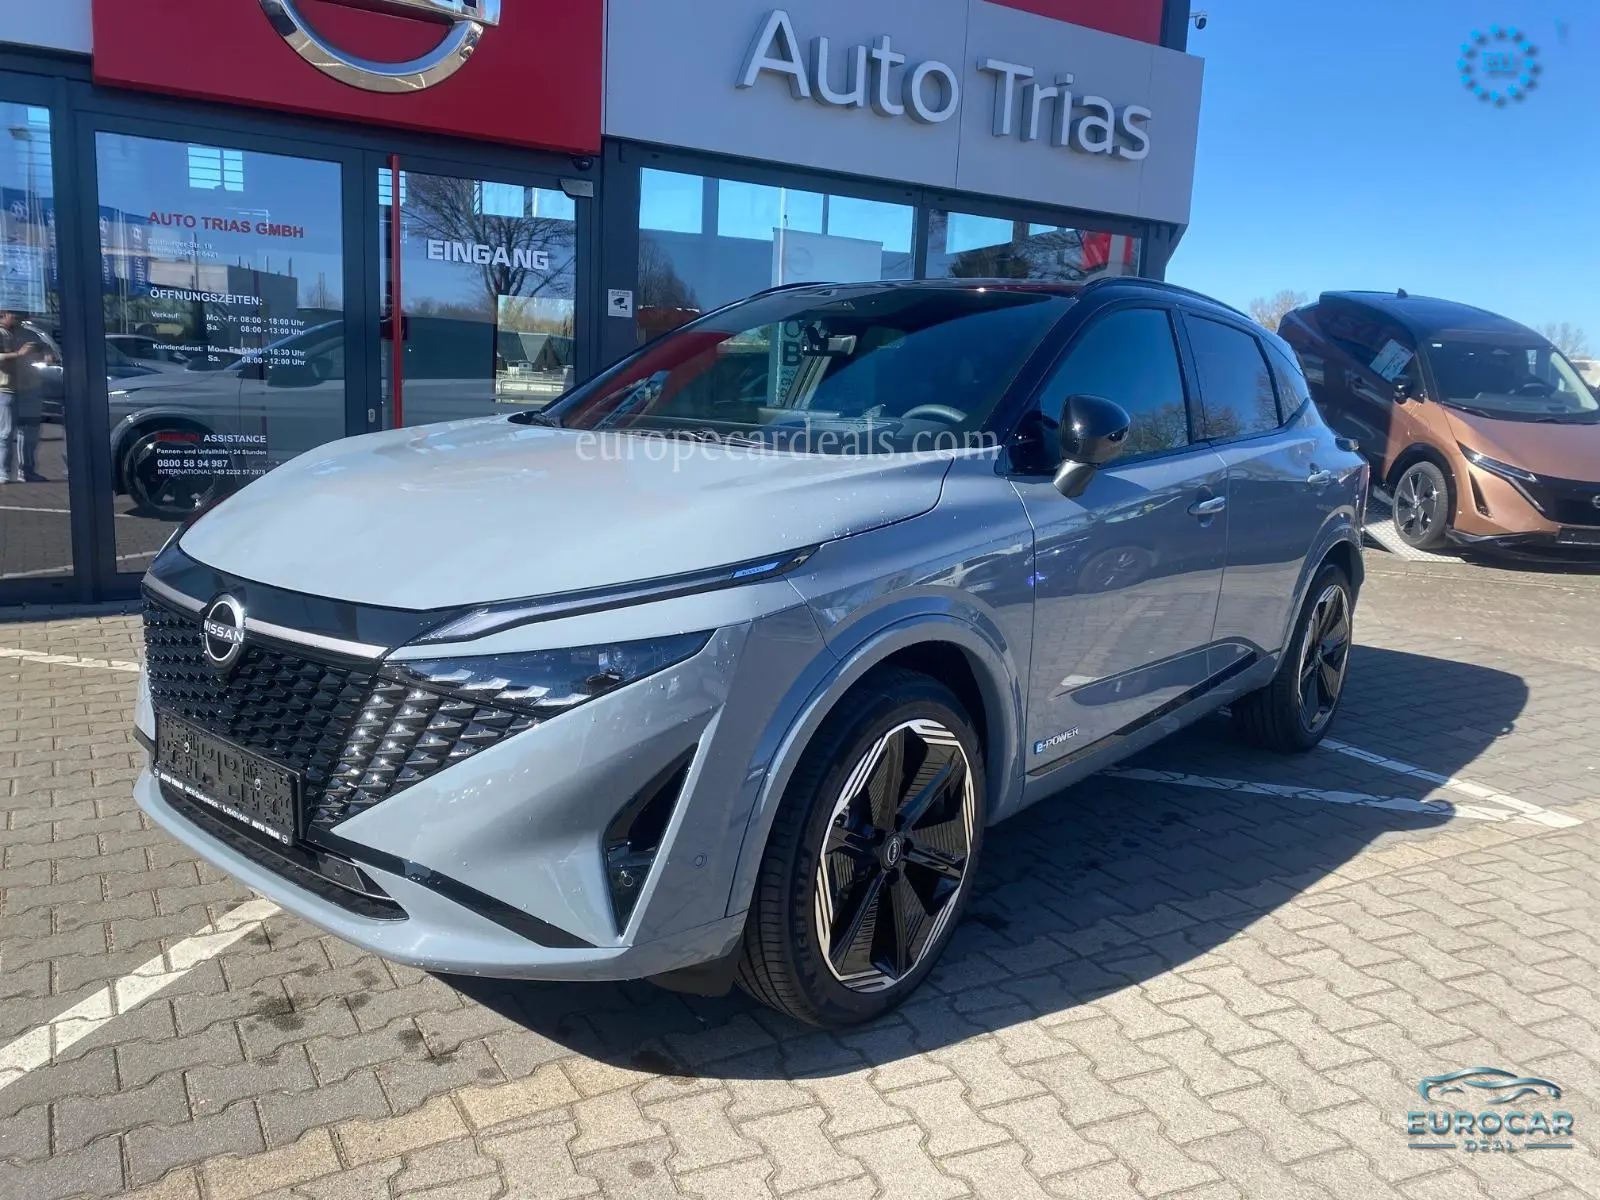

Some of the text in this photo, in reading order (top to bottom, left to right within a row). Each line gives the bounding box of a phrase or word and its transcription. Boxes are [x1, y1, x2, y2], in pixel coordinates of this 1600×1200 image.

[735, 9, 1152, 161] Auto Trias
[147, 211, 304, 238] AUTO TRIAS GMBH
[427, 239, 549, 270] EINGANG
[150, 286, 263, 306] ÖFFNUNGSZEITEN:
[206, 313, 221, 321] Mo.
[291, 319, 305, 327] Uhr
[206, 323, 220, 331] Sa.
[240, 325, 262, 333] 08:00
[152, 343, 203, 352] Kundendienst:
[241, 356, 263, 364] 08:00
[270, 358, 290, 366] 12:00
[203, 434, 267, 443] ASSISTANCE
[157, 459, 228, 467] 0800 58 94 987
[203, 619, 244, 643] NISSAN
[1034, 727, 1079, 754] e-POWER
